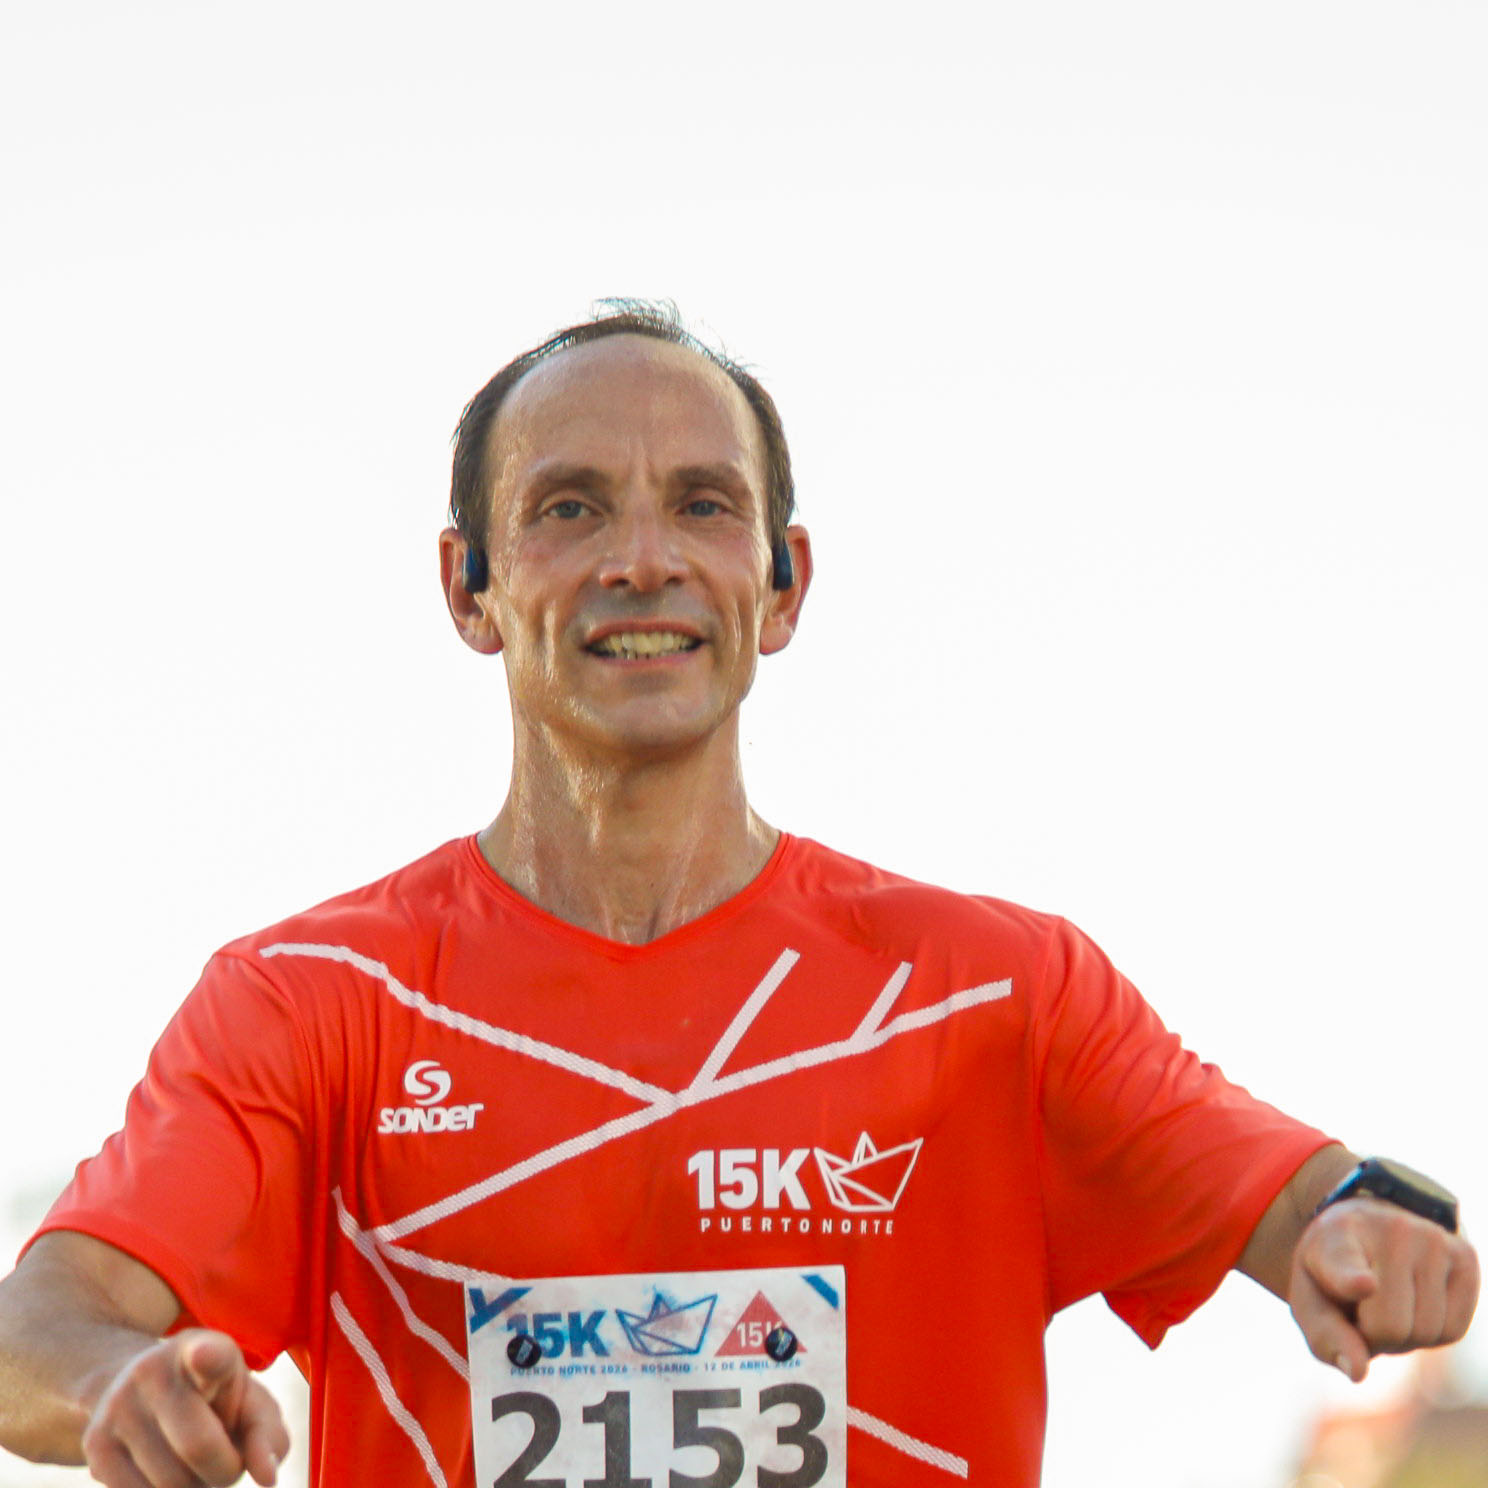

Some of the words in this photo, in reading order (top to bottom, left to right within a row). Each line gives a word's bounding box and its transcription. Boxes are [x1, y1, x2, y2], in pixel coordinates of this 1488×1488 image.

[687, 1148, 812, 1211] 15K
[559, 1363, 596, 1376] NORTE
[641, 1362, 691, 1375] ROSARIO
[721, 1360, 735, 1371] DE
[739, 1360, 770, 1371] ABRIL
